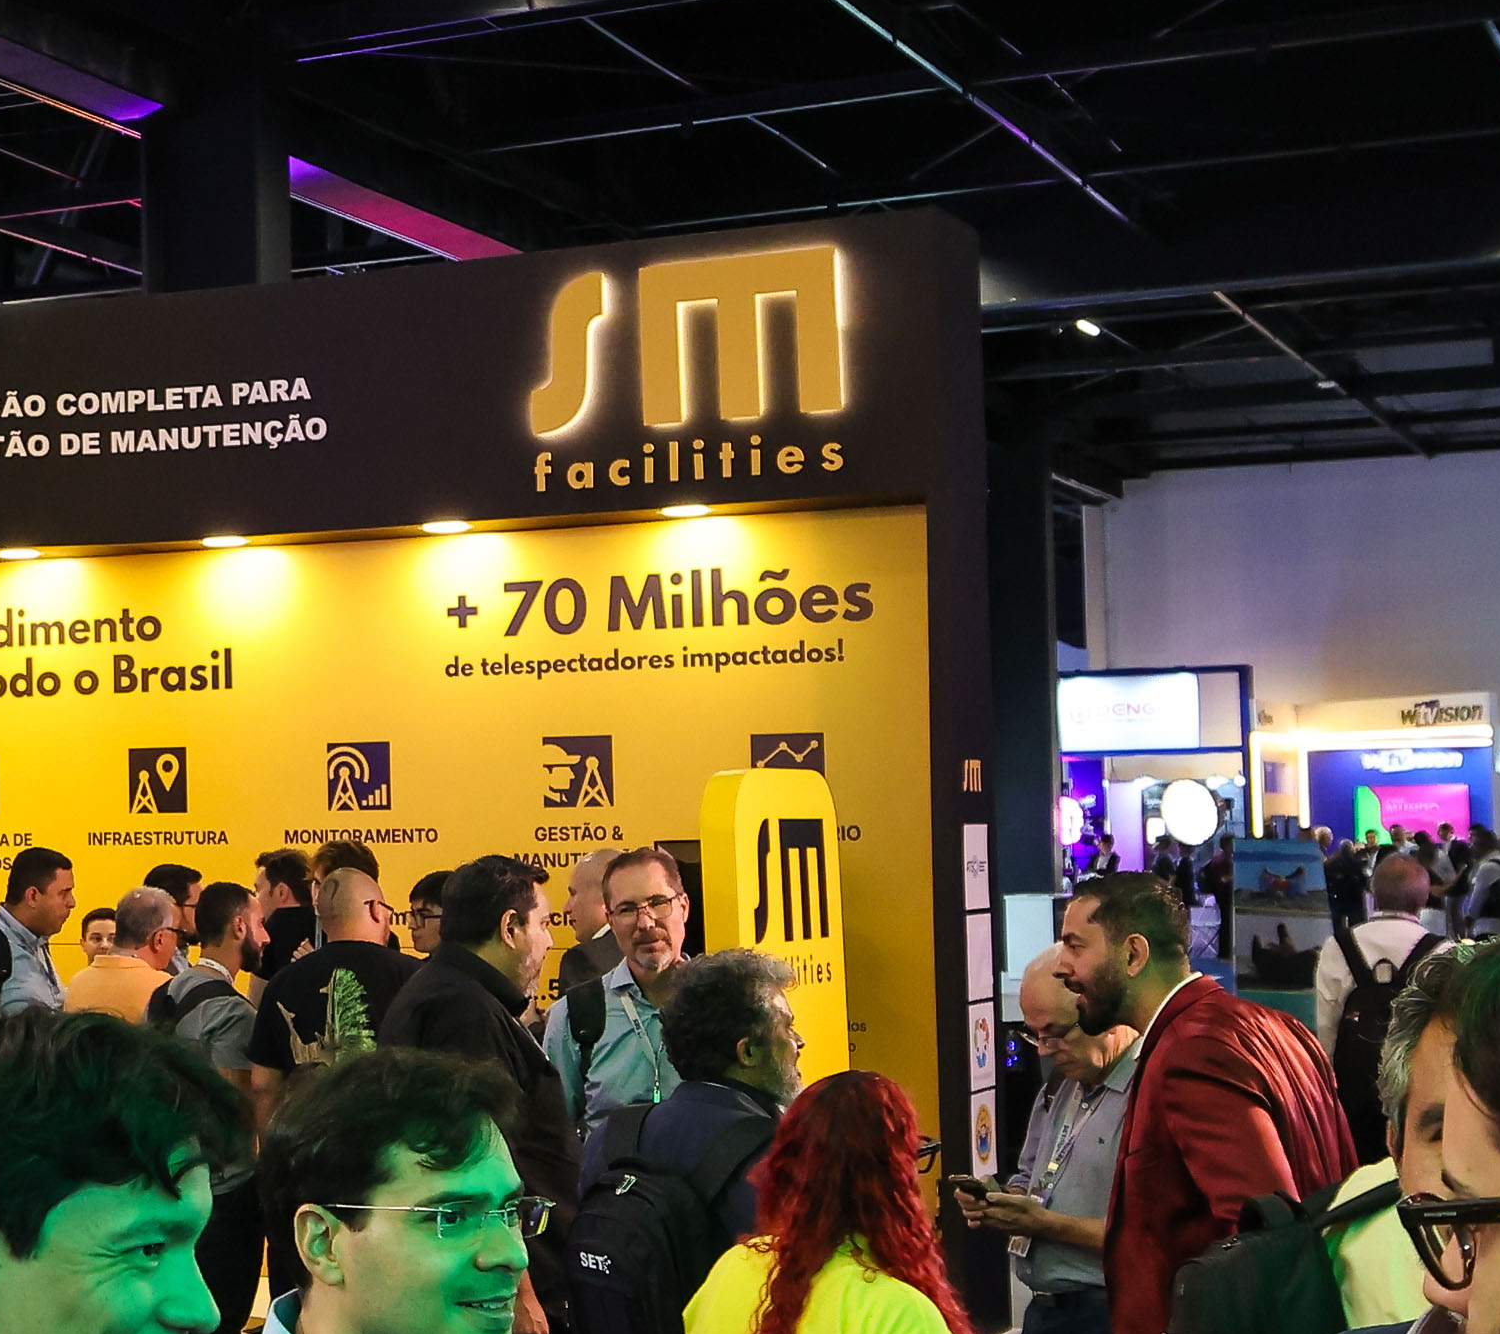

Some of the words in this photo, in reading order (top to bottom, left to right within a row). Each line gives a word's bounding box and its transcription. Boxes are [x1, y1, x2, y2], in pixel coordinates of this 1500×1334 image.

[55, 384, 222, 417] COMPLETA
[231, 376, 311, 405] PARA
[59, 430, 102, 456] DE
[109, 413, 328, 454] MANUTENÇÃO
[534, 433, 845, 494] facilities
[446, 594, 480, 630] +
[503, 577, 587, 639] 70
[607, 568, 876, 634] Milhões
[73, 668, 100, 697] o
[113, 647, 235, 696] Brasil
[444, 654, 475, 680] de
[481, 646, 675, 681] telespectadores
[682, 638, 846, 674] impactados!
[13, 833, 33, 847] DE
[87, 831, 229, 847] INFRAESTRUTURA
[284, 828, 439, 845] MONITORAMENTO
[534, 822, 606, 842] GESTÃO
[611, 825, 625, 841] &
